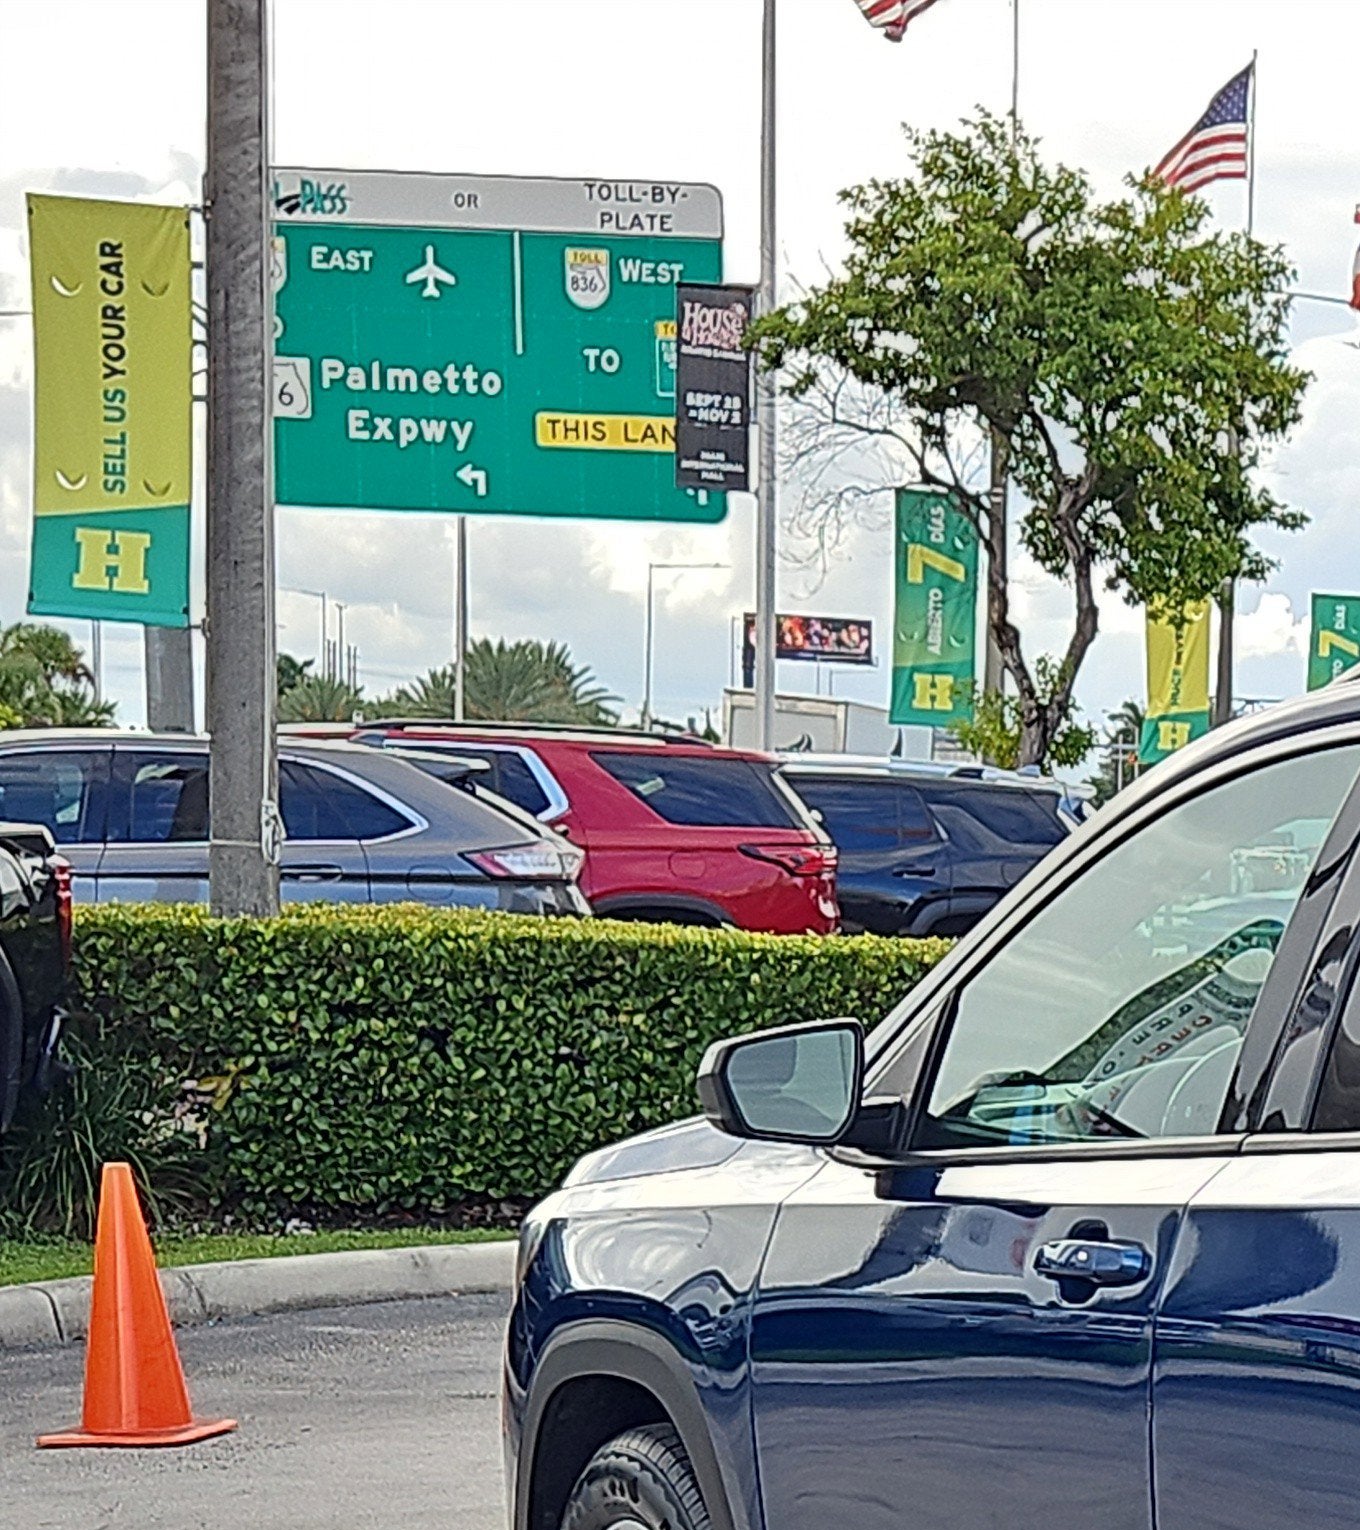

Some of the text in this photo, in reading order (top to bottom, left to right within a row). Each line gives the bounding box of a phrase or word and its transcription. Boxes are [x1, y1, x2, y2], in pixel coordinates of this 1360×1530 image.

[454, 192, 478, 208] OR
[600, 211, 673, 232] PLATE
[311, 245, 373, 271] EAST
[572, 251, 601, 264] TOLL
[618, 258, 684, 283] WEST
[571, 275, 598, 293] 836
[99, 240, 126, 494] SELL US YOUR CAR
[582, 348, 620, 373] TO
[321, 358, 502, 396] Palmetto
[347, 409, 473, 451] Expwy
[546, 419, 677, 444] THIS LAN
[72, 526, 151, 594] H
[906, 543, 966, 584] 7
[1317, 629, 1360, 658] 7
[912, 672, 954, 711] H
[1157, 721, 1192, 751] H
